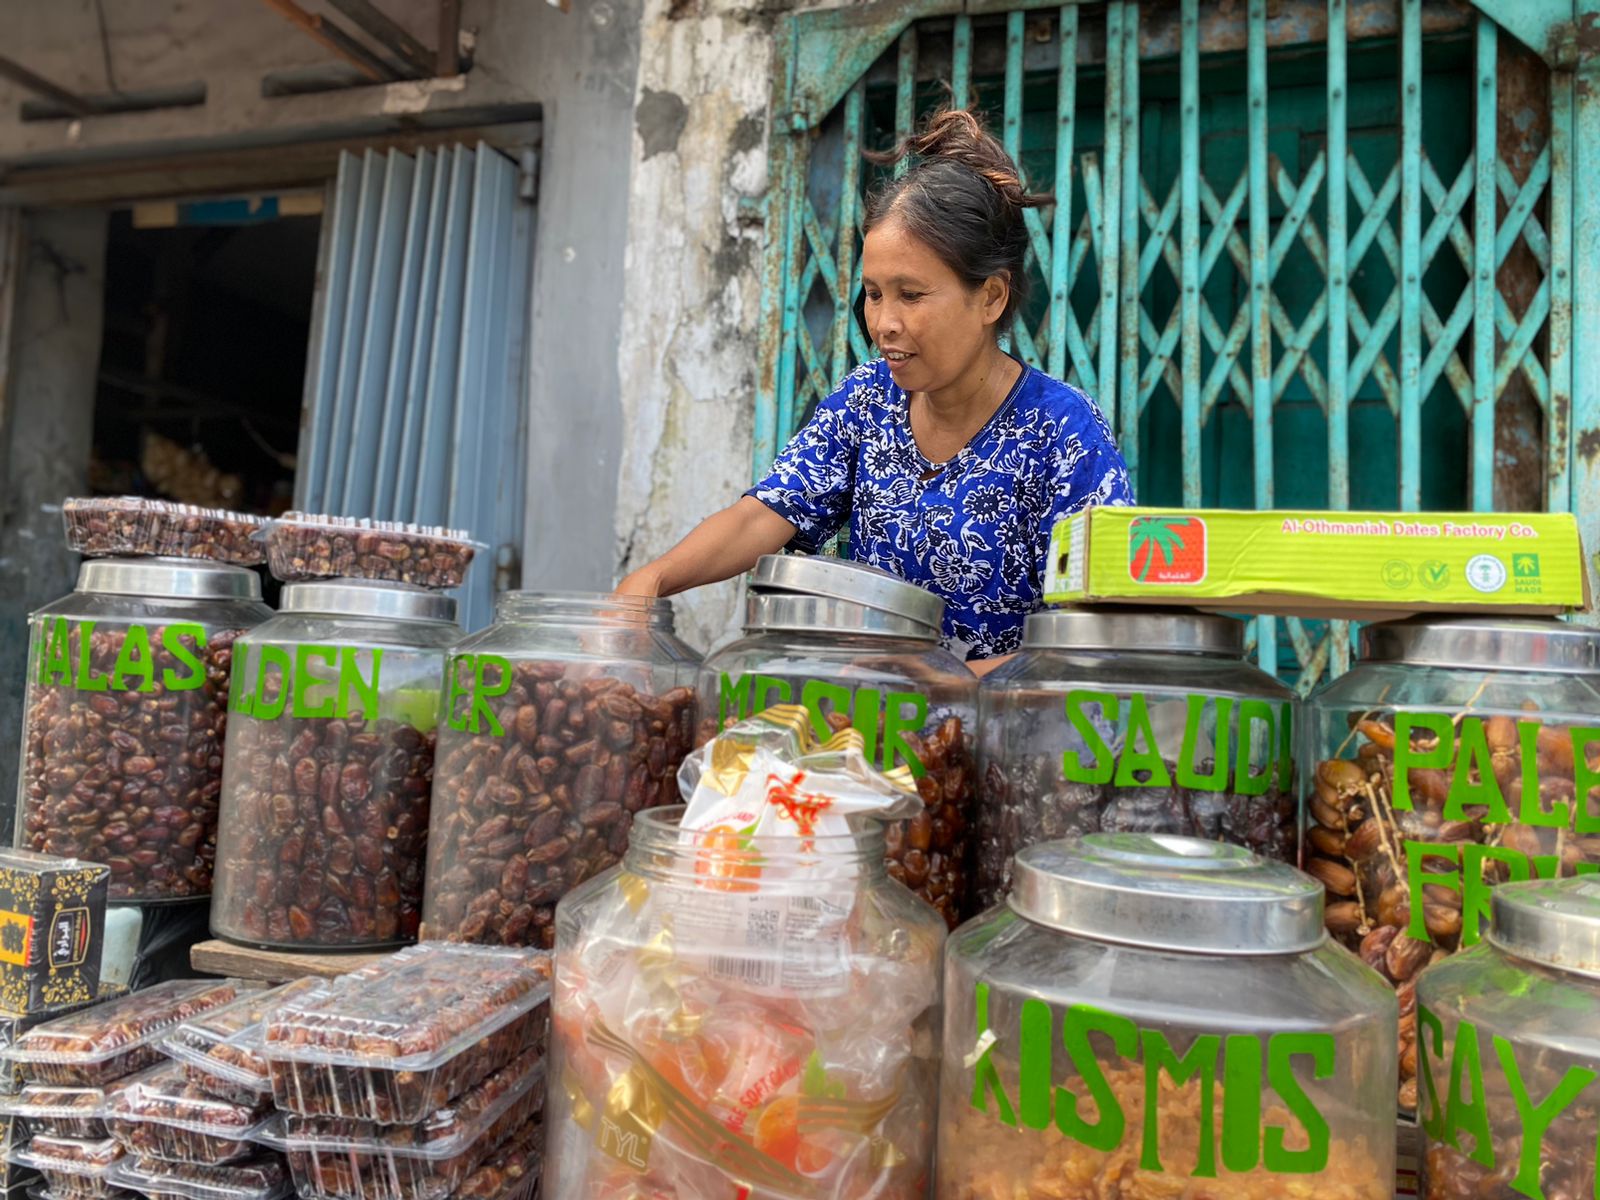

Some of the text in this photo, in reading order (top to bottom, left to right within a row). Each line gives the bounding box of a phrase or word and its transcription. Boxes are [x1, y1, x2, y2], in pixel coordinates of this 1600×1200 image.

[1281, 519, 1538, 539] Al-Othmaniah Dates Factory Co.
[1063, 689, 1293, 796] SAUDI
[970, 982, 1335, 1178] KISMIS
